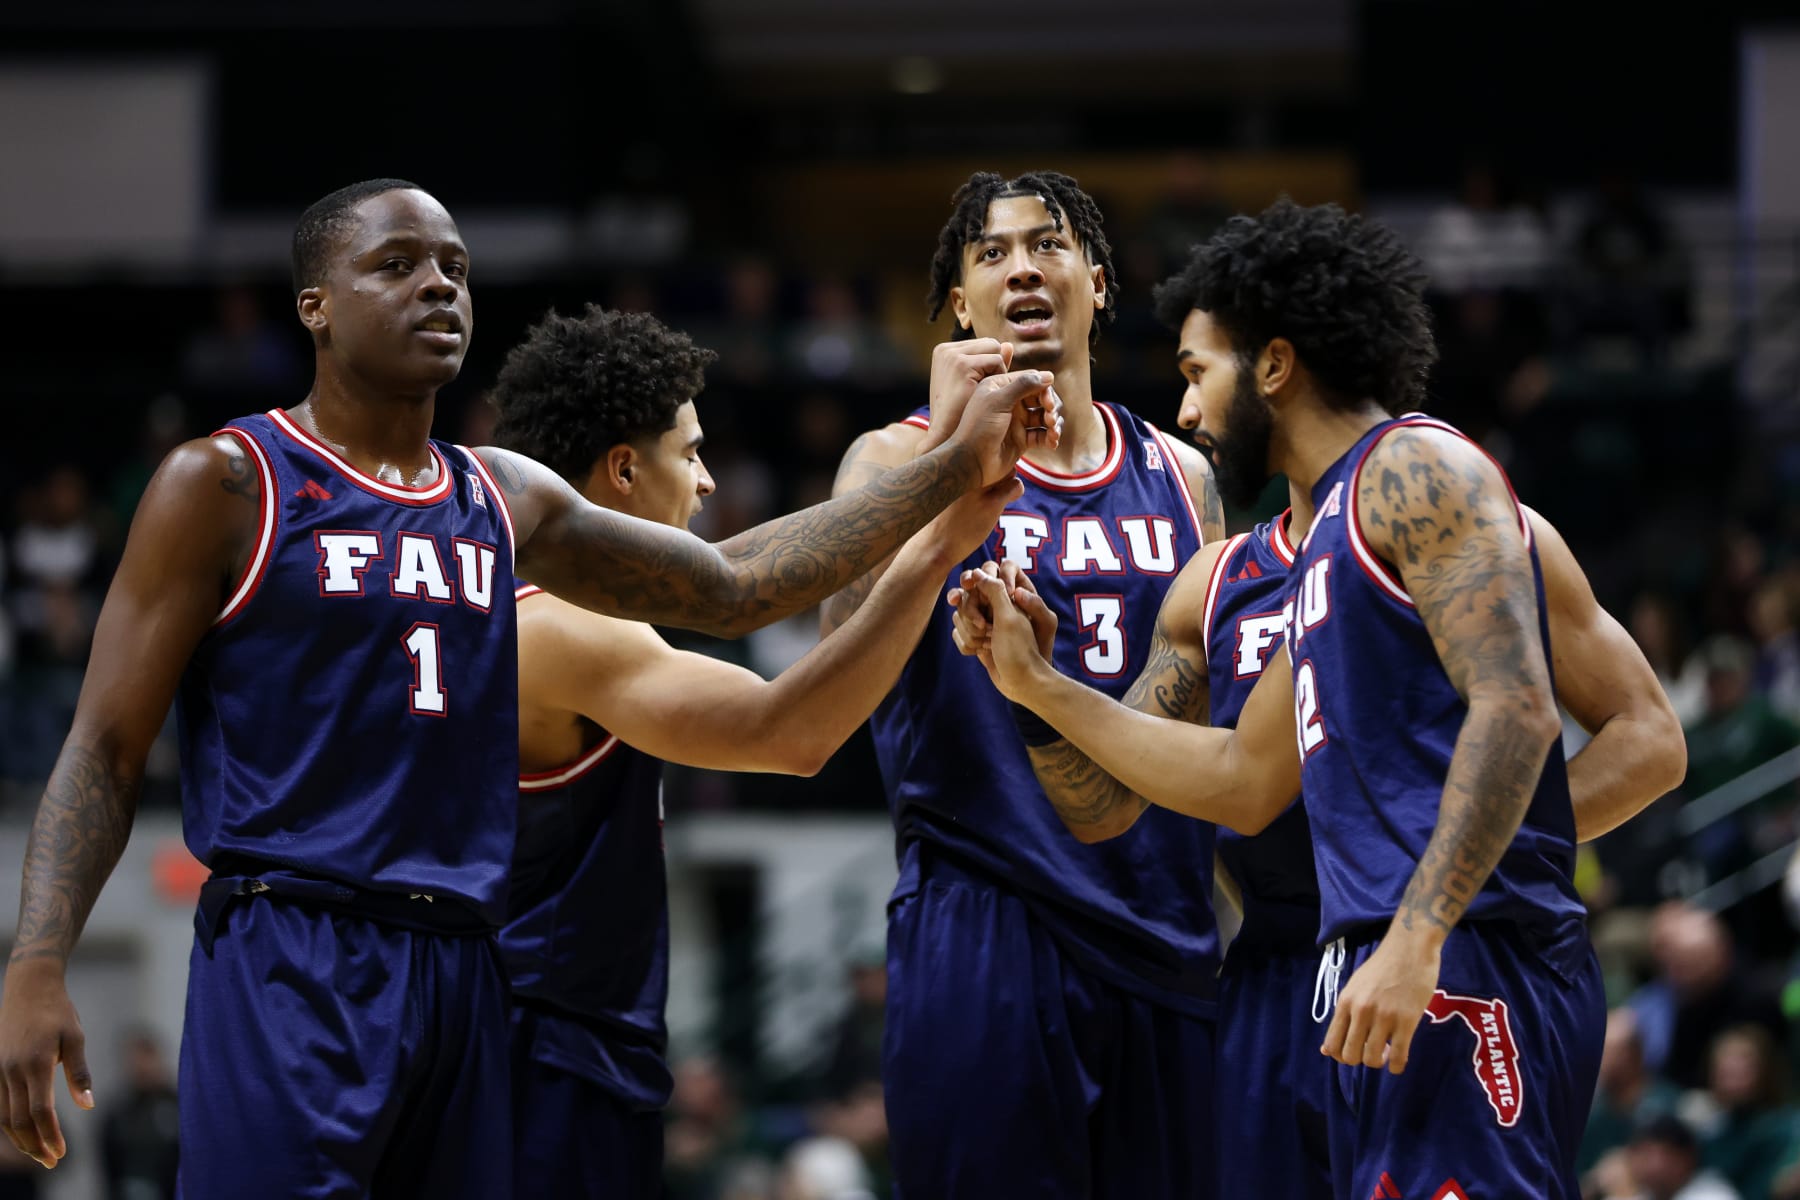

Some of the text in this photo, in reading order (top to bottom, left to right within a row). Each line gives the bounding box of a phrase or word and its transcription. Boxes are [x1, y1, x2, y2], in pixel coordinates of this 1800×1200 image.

[313, 529, 497, 614] FAU
[994, 510, 1179, 577] FAU
[400, 621, 448, 718] 1
[1074, 593, 1129, 680] 3
[1234, 610, 1286, 681] F
[1154, 660, 1198, 719] God
[1479, 1011, 1516, 1108] ATLANTIC
